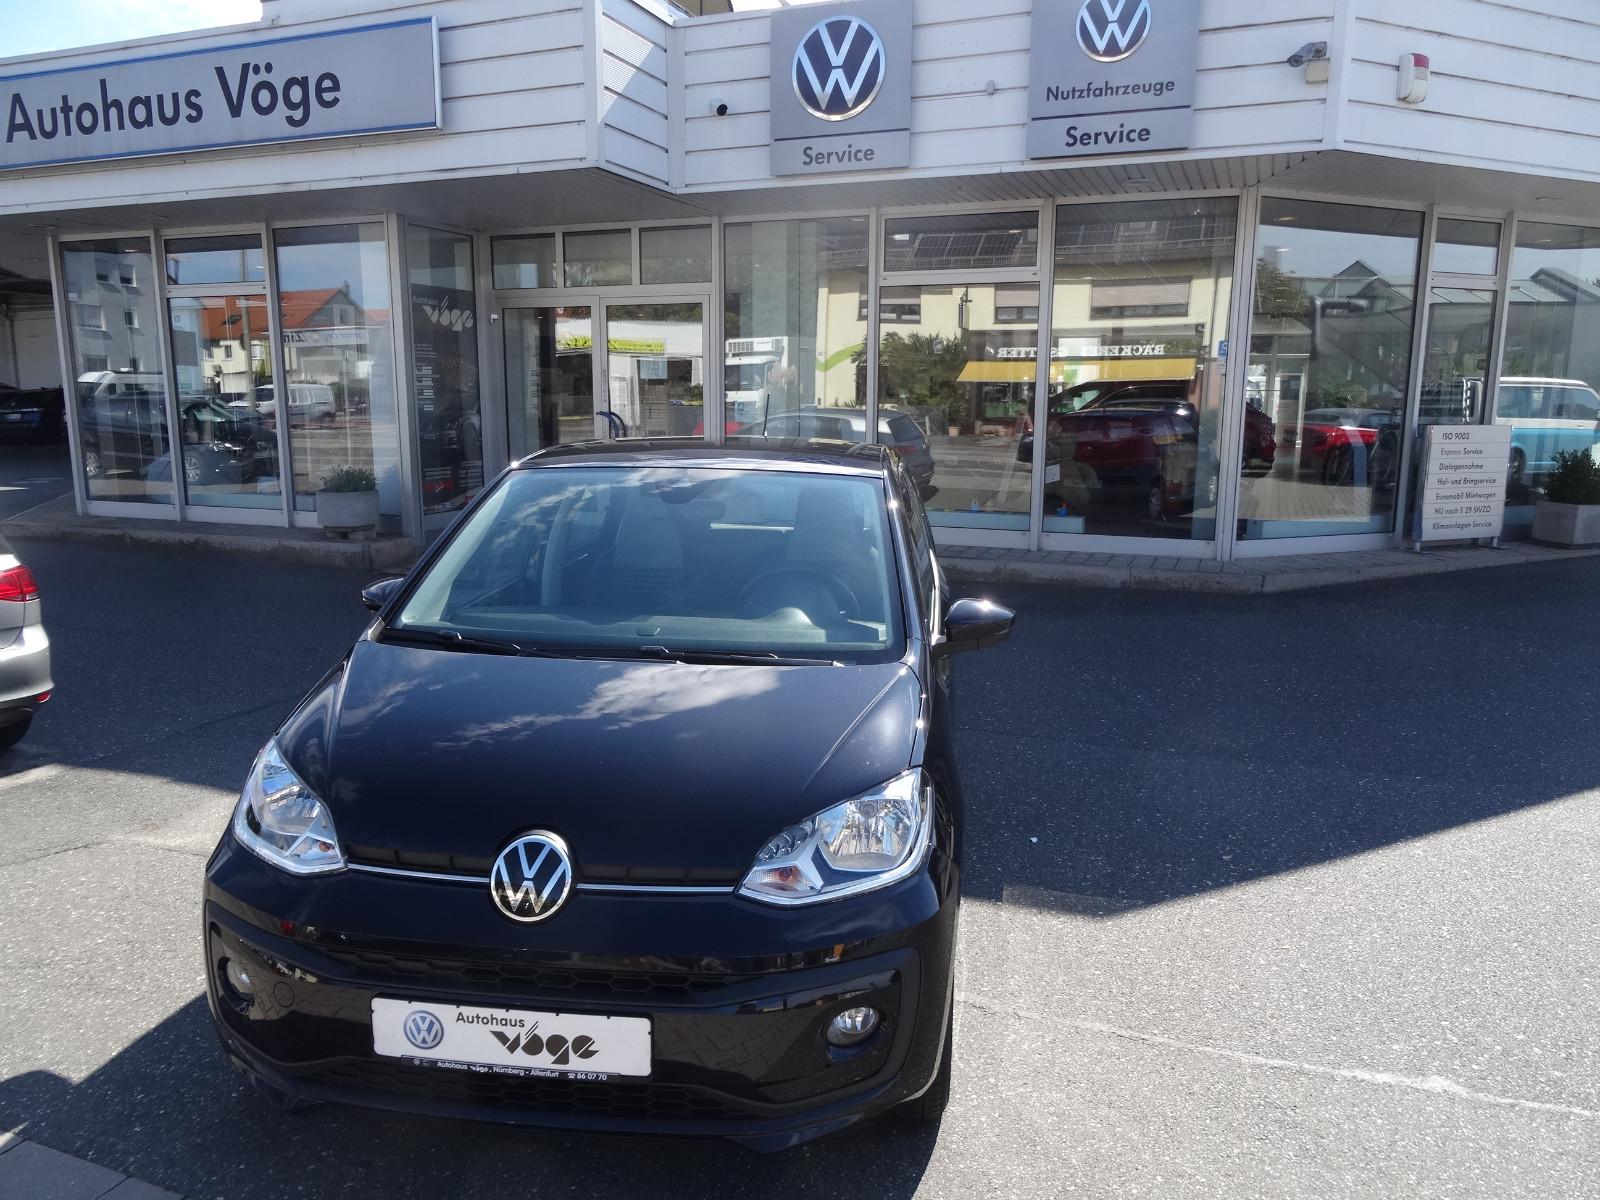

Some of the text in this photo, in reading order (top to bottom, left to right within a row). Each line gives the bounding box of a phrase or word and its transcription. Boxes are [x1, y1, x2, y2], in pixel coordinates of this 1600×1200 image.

[1046, 80, 1175, 101] Nutzfahrzeuge
[6, 62, 341, 143] Autohaus Vöge
[1065, 123, 1151, 147] Service
[802, 144, 875, 165] Service
[1442, 432, 1470, 440] ISO 9002
[1440, 447, 1483, 456] Express Service
[1451, 477, 1461, 485] und
[1463, 476, 1496, 486] Bringservice
[1465, 492, 1496, 500] Mietwagen
[456, 1011, 525, 1028] Autohaus
[437, 1061, 468, 1070] Autohaus
[493, 1065, 525, 1076] Nürnberg
[598, 1073, 607, 1081] 70
